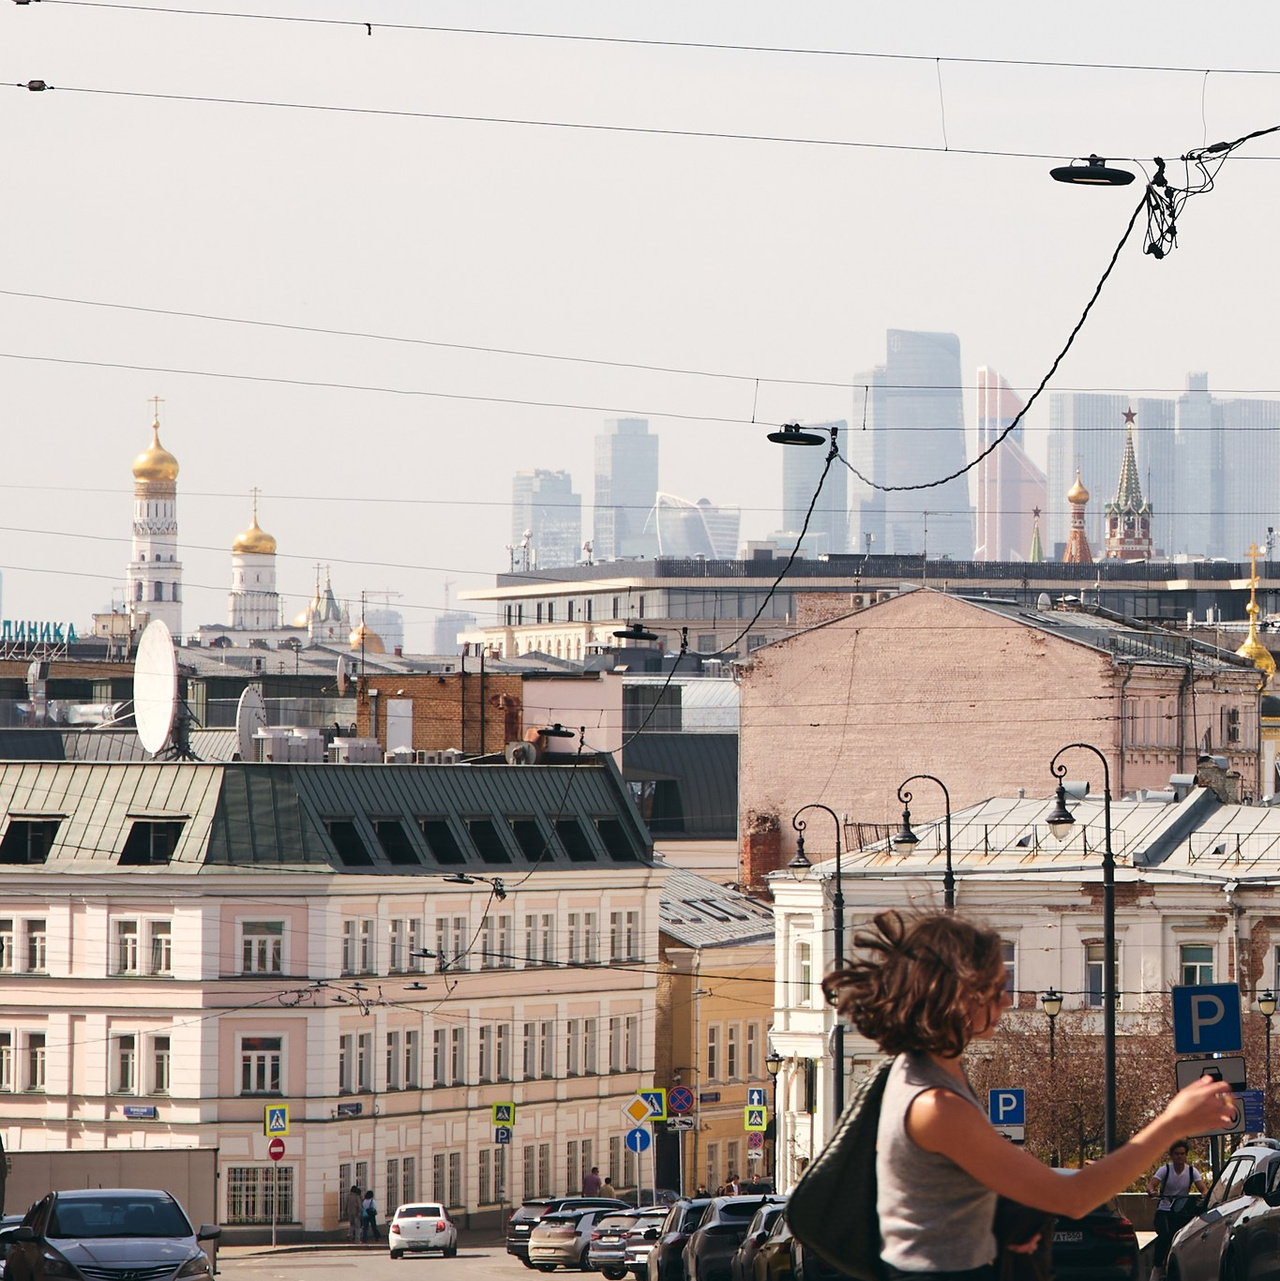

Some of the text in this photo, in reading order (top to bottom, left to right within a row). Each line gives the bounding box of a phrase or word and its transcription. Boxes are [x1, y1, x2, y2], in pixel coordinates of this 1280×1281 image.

[1191, 994, 1225, 1045] P
[999, 1093, 1018, 1121] P
[498, 1129, 508, 1143] P
